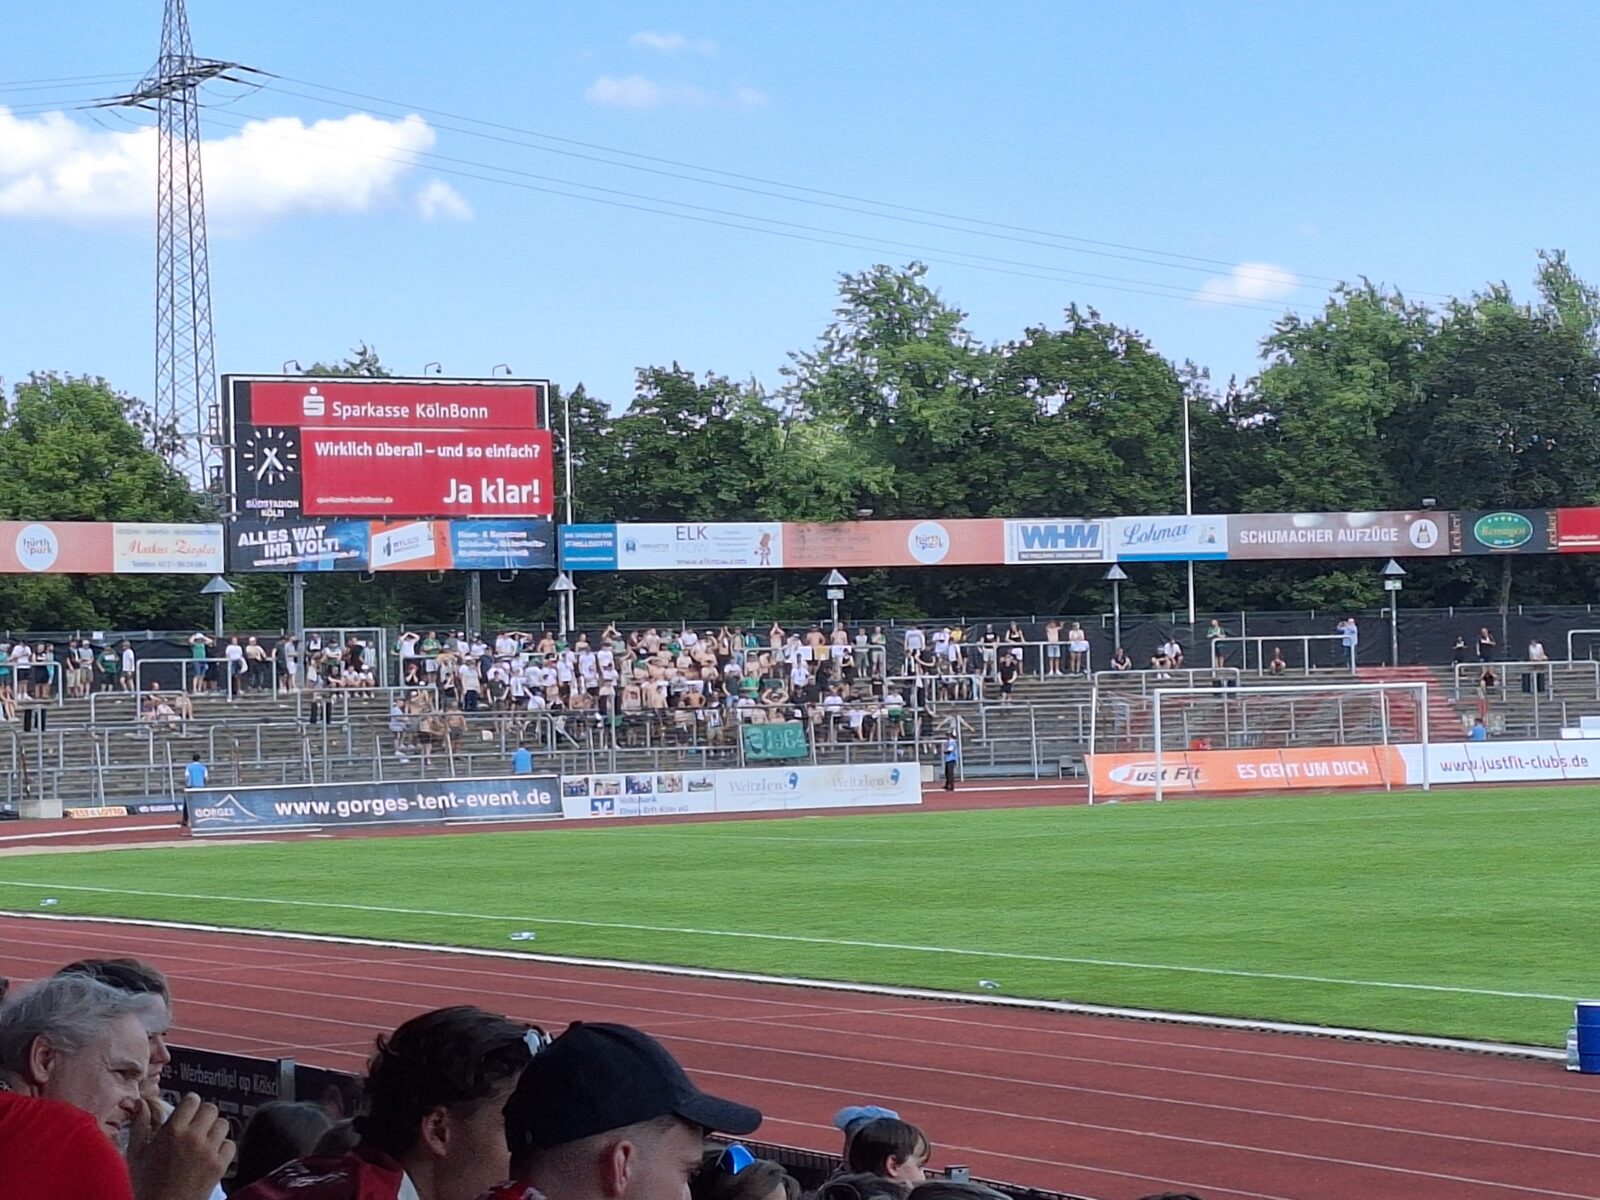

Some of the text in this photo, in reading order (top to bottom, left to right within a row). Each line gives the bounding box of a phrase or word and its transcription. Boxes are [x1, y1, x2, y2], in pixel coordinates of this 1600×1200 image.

[332, 401, 489, 419] Sparkasse KölnBonn
[315, 442, 372, 457] Wirklich
[376, 442, 423, 457] überall
[438, 444, 463, 458] und
[466, 447, 482, 458] so
[484, 444, 541, 458] einfach?
[443, 478, 540, 504] Ja klar!
[260, 508, 285, 518] KÖLN
[237, 525, 327, 547] ALLES WAT
[675, 526, 708, 541] ELK
[1020, 524, 1100, 549] WHM
[1120, 521, 1193, 546] Lohmar
[1240, 525, 1398, 544] SCHUMACHER AUFZÜGE
[264, 542, 292, 558] IHR
[295, 537, 340, 554] VOLT!
[1236, 761, 1369, 779] ES GEHT UM DICH
[1440, 754, 1589, 774] www.justfit-clubs.de
[1122, 767, 1201, 782] Just Fit
[274, 788, 552, 818] www.gorges-tent-event.de
[179, 1062, 237, 1089] Werbeartikel
[253, 1073, 279, 1097] Kölsc
